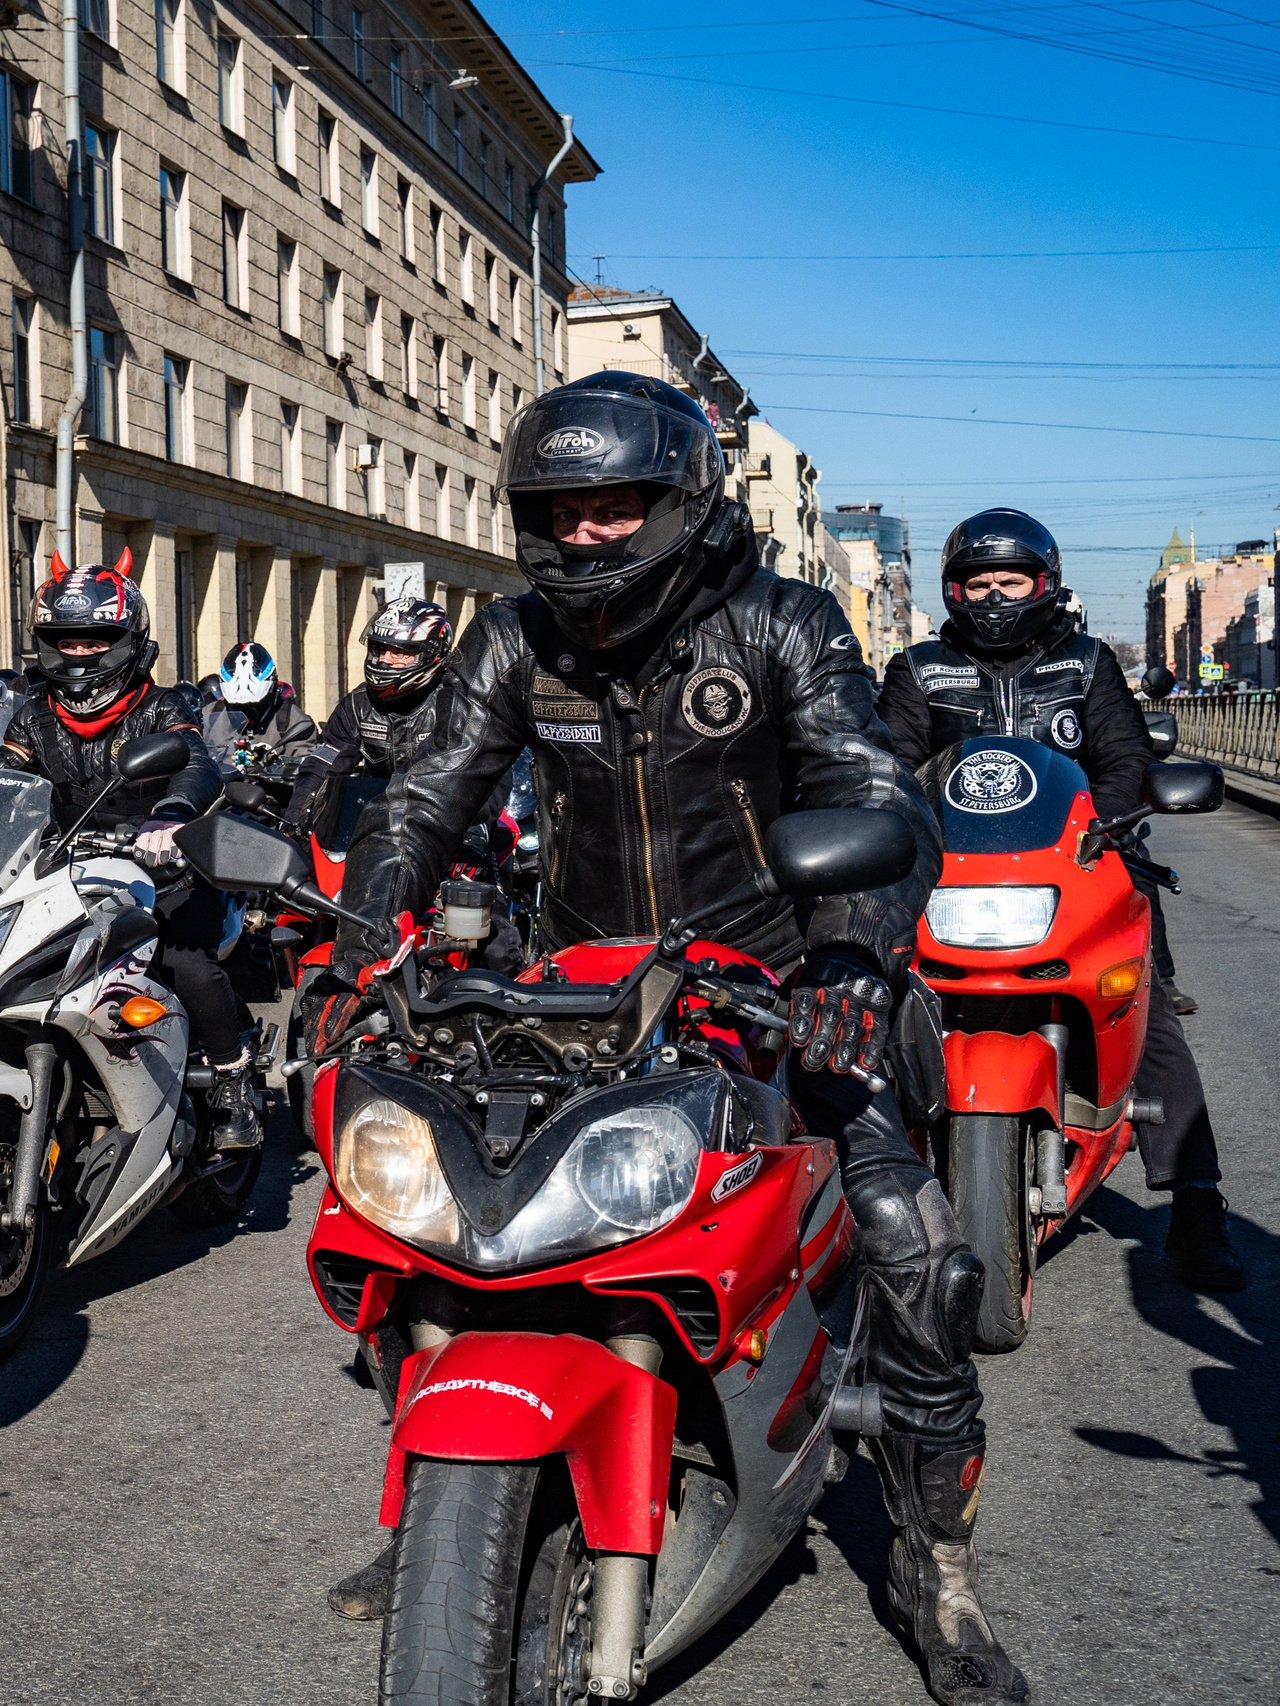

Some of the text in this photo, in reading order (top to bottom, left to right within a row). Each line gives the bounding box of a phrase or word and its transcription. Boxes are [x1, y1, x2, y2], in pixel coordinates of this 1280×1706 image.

[542, 431, 595, 451] Airoh
[57, 596, 87, 606] Airoh
[923, 666, 936, 675] THE
[1038, 661, 1083, 672] PROSPEC
[966, 752, 1014, 765] THE ROCKERS
[959, 795, 1022, 811] ST.PETERSBURG
[719, 1158, 759, 1197] SHOEI
[112, 1180, 165, 1238] YAMAHA
